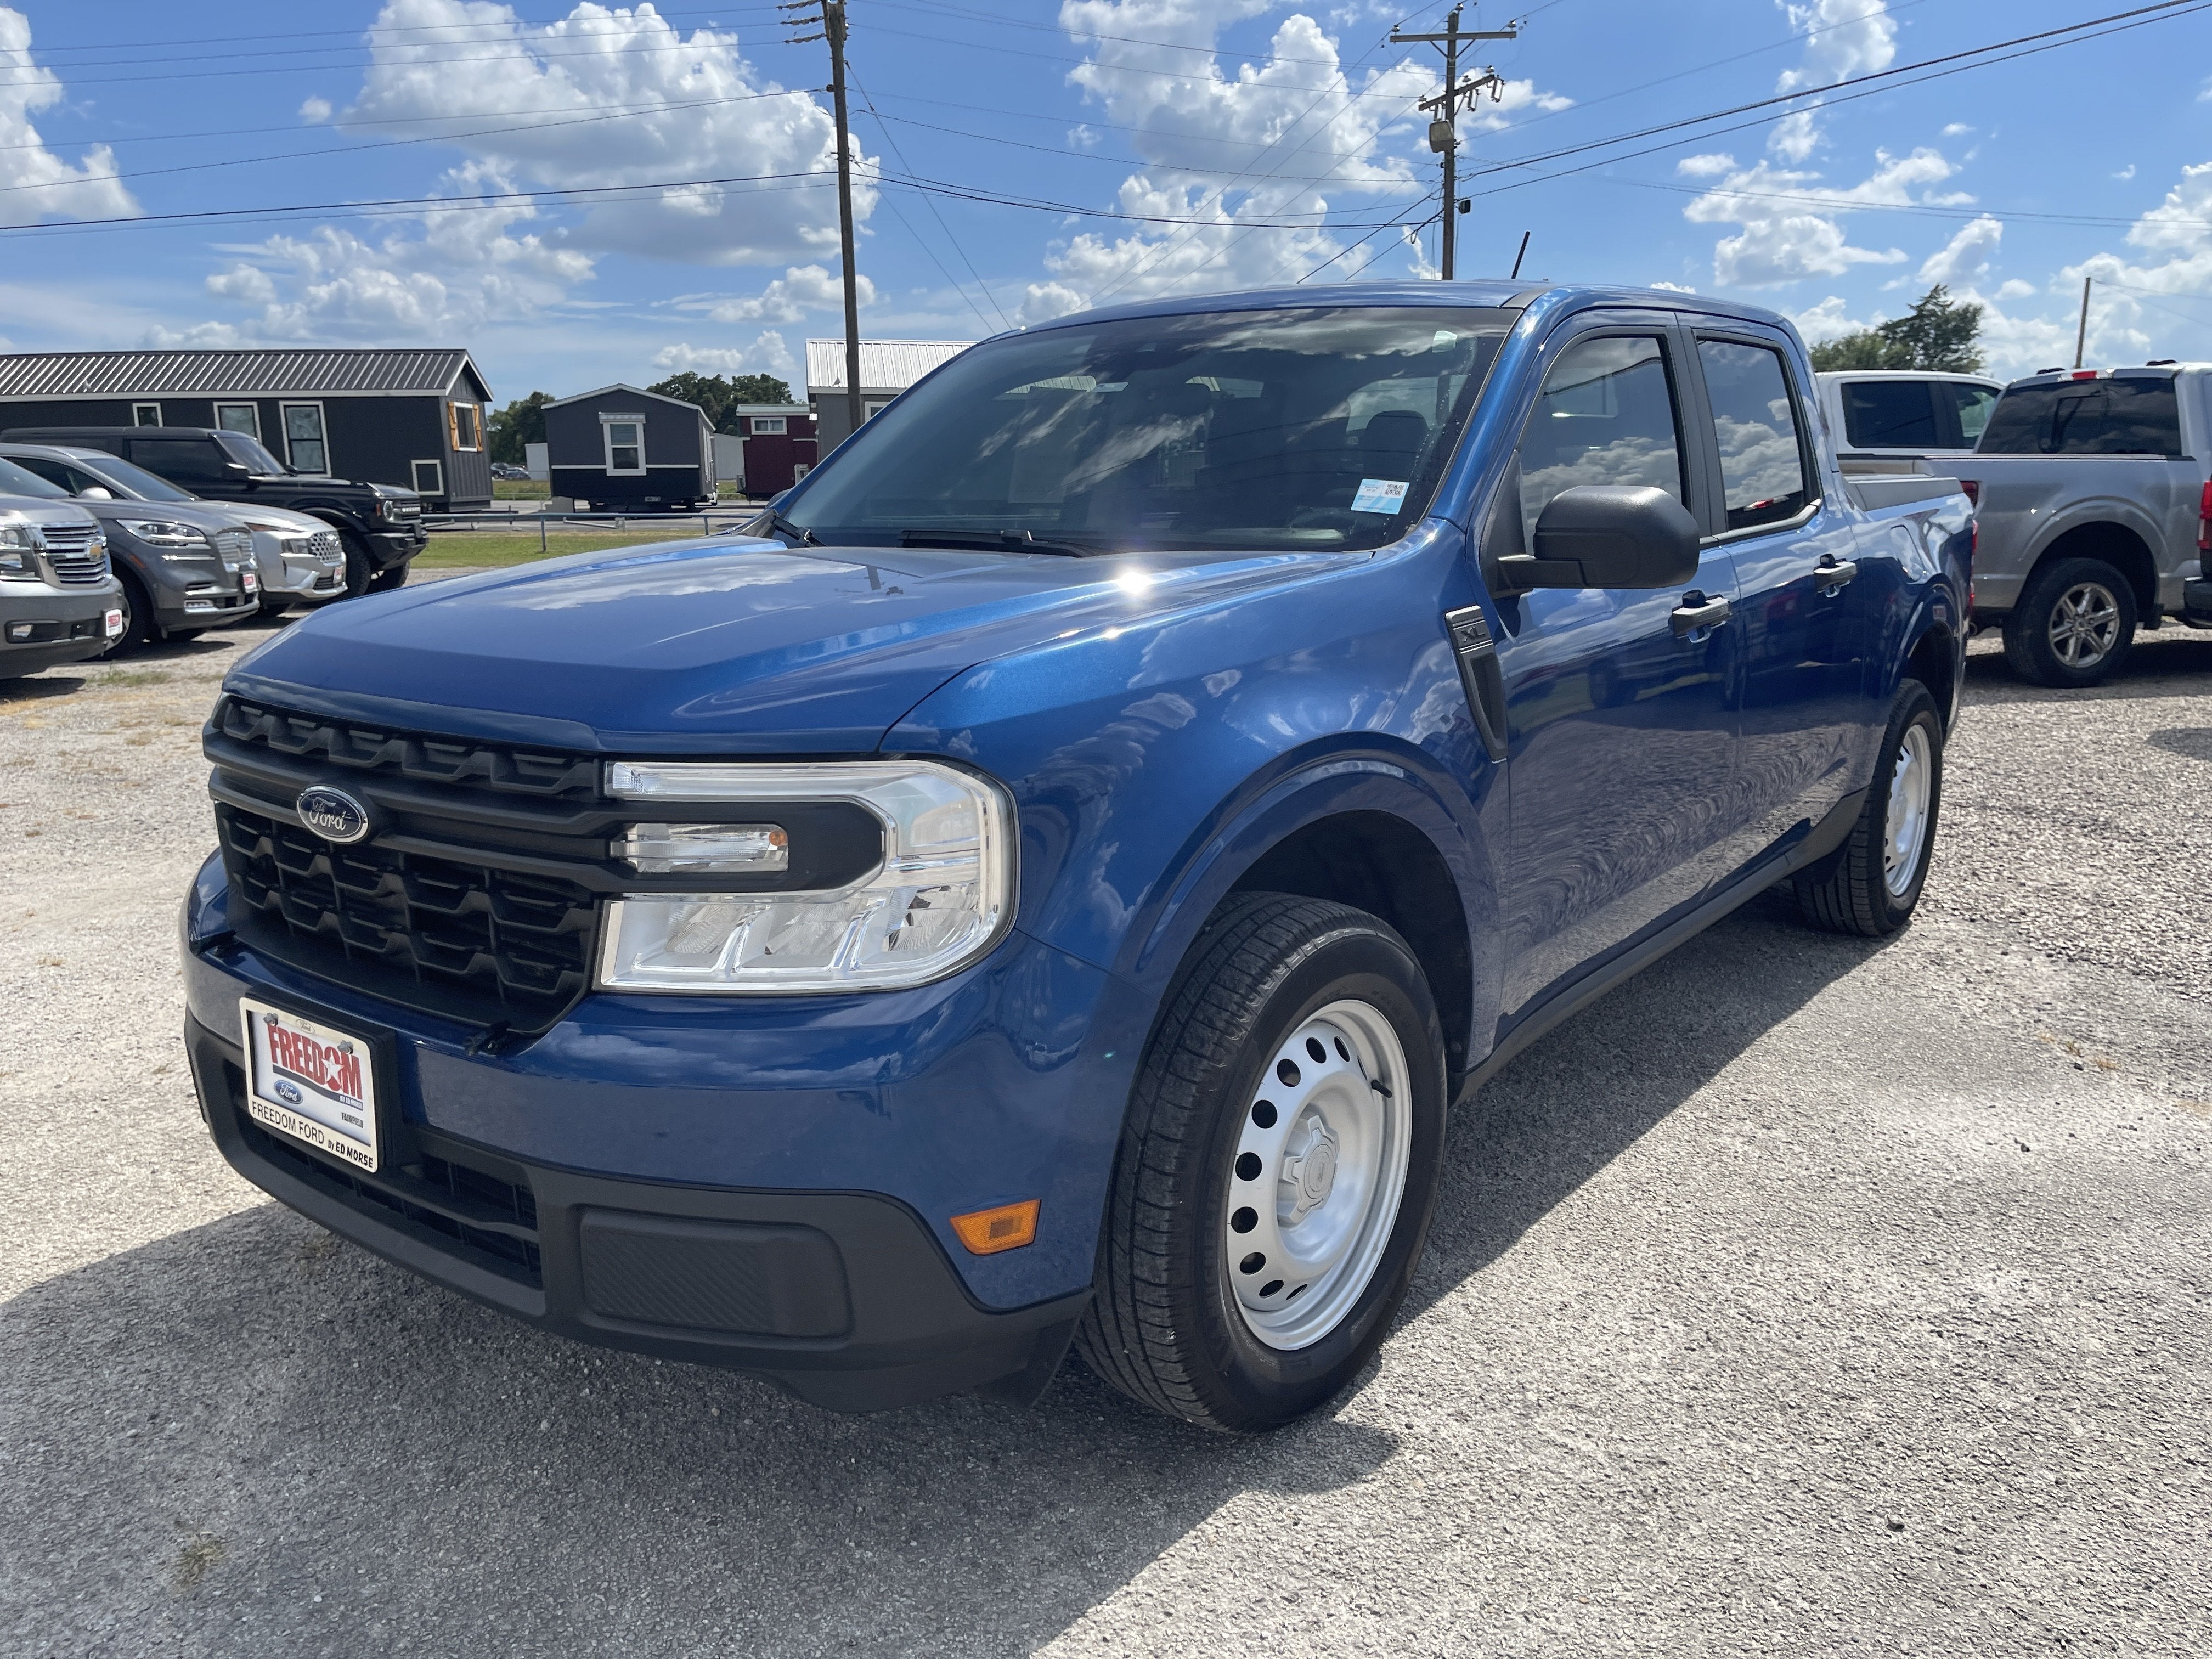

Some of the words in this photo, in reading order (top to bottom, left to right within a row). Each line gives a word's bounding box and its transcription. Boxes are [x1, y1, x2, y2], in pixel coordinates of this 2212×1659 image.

[1461, 627, 1486, 641] XL
[309, 797, 347, 831] Ford
[267, 1023, 363, 1100] FREEDOM
[280, 1083, 298, 1101] Ford
[341, 1112, 363, 1128] FAIRFIELD
[252, 1101, 296, 1133] FREEDOM
[299, 1121, 324, 1145] FORD
[336, 1141, 345, 1155] ED
[347, 1146, 373, 1168] MORSE
